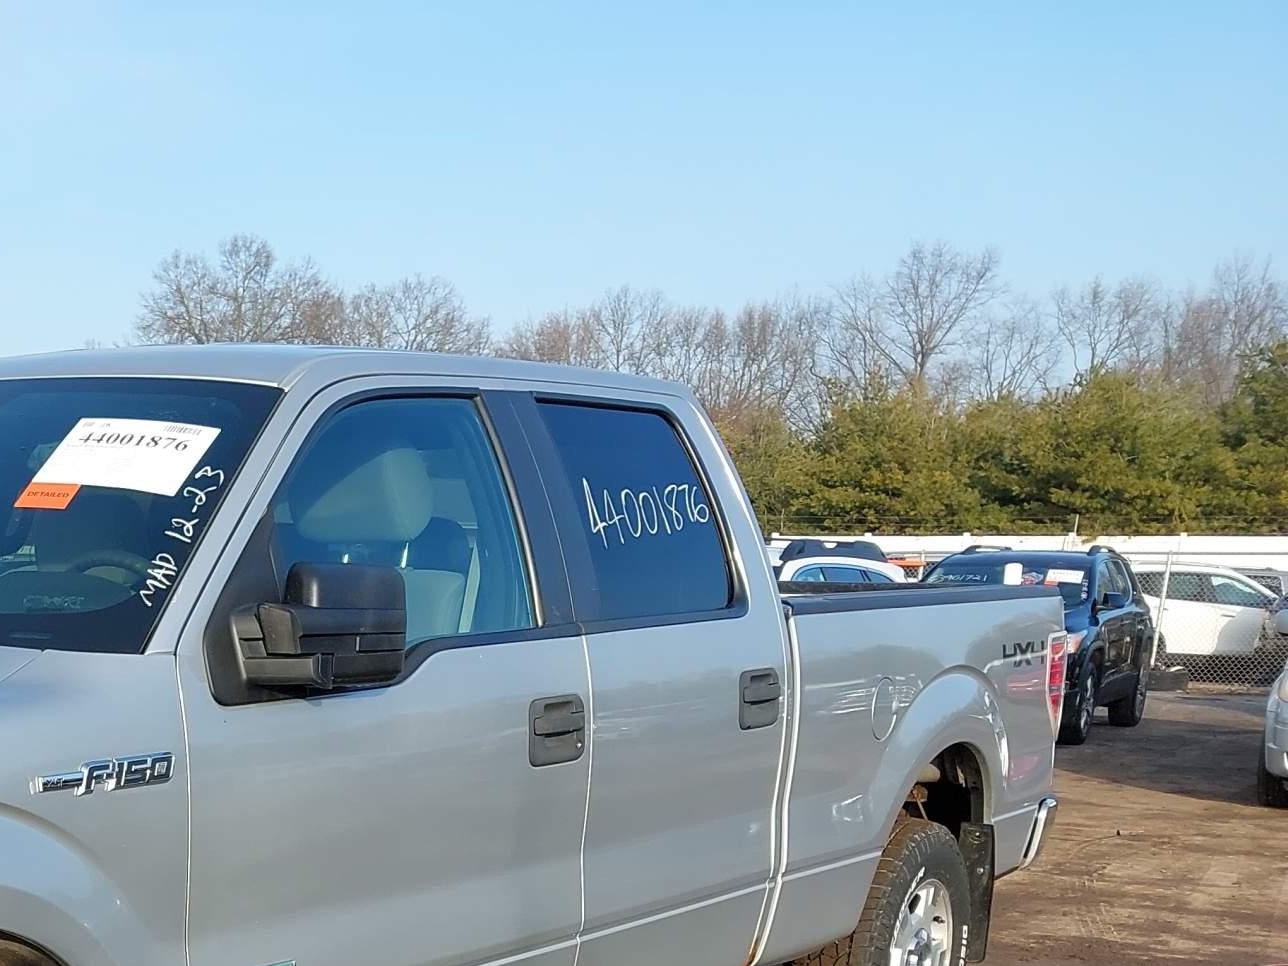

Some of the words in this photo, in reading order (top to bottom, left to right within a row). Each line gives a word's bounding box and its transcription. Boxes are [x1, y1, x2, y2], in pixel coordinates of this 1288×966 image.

[78, 432, 192, 451] 44001876
[26, 490, 70, 498] DETAILED
[582, 477, 710, 549] 44001876
[139, 552, 178, 607] MAD
[164, 465, 225, 543] 12-23
